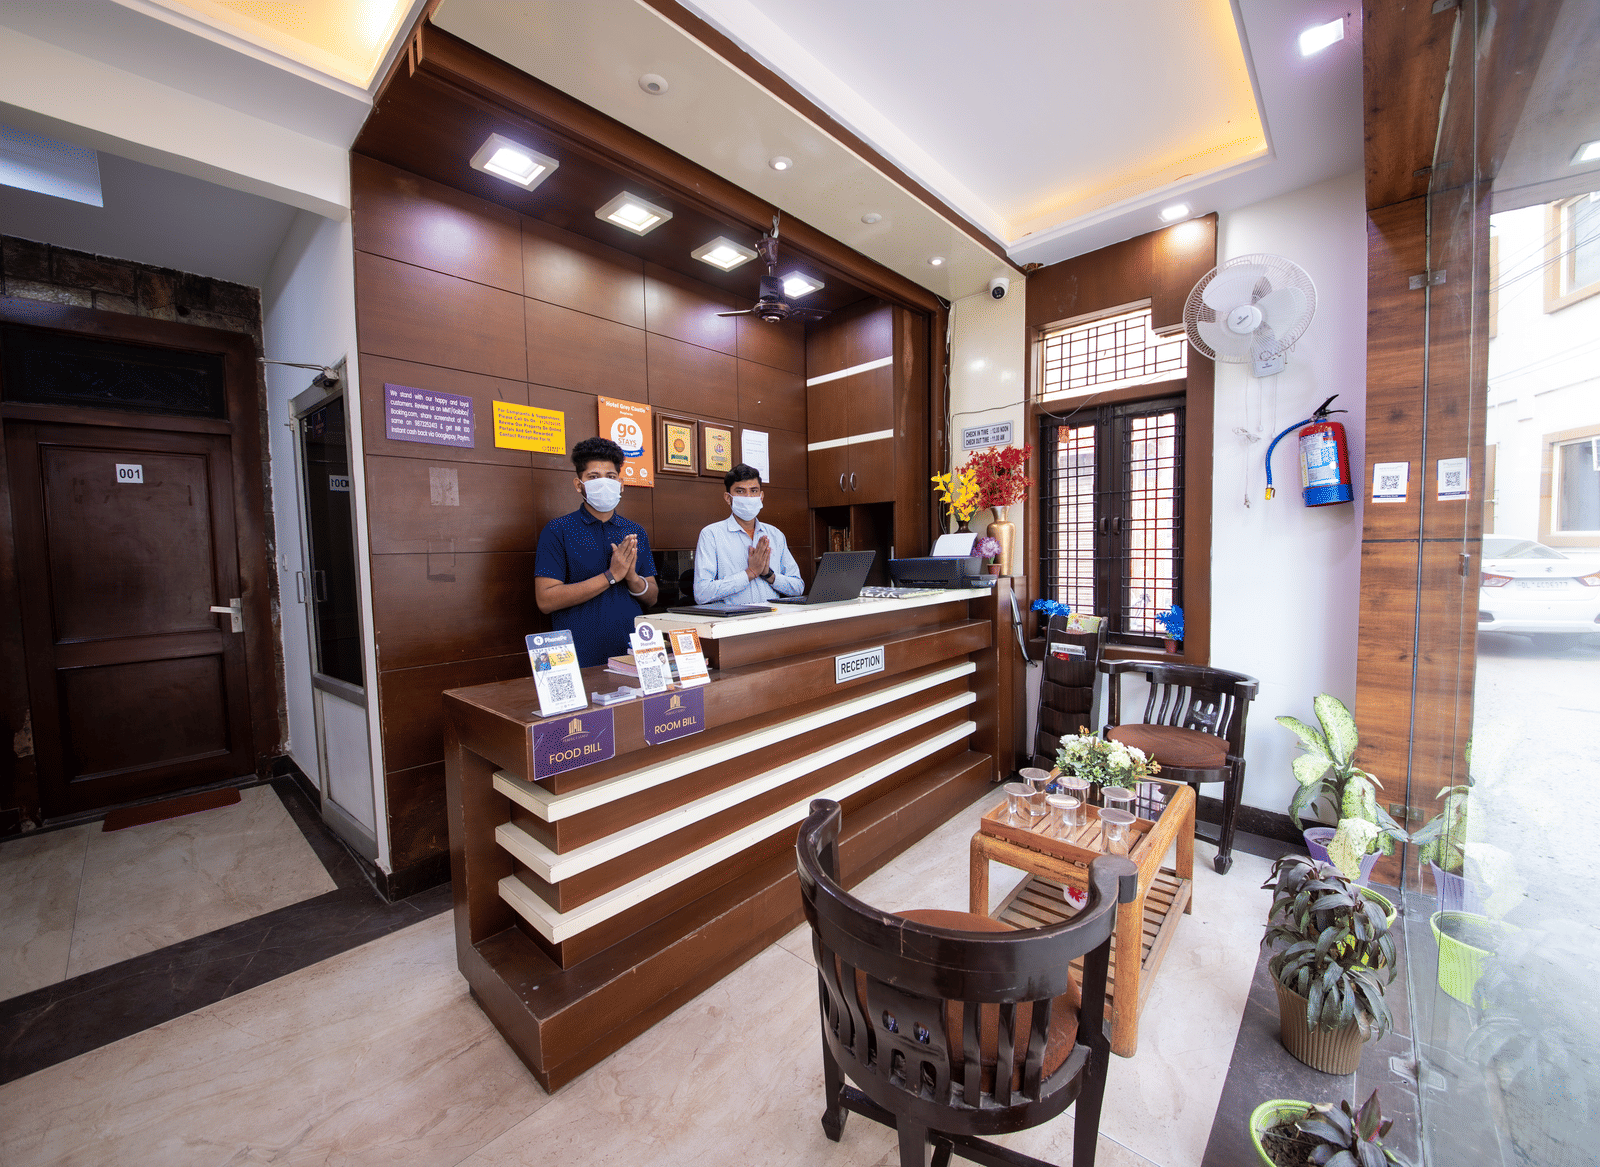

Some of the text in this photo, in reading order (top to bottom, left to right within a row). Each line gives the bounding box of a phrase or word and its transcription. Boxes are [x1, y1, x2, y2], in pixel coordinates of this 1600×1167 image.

[435, 397, 448, 406] happy
[617, 423, 636, 438] go
[618, 438, 636, 446] STAYS
[120, 468, 140, 479] 001
[841, 655, 880, 674] RECEPTION
[655, 716, 696, 734] ROOM BILL
[549, 742, 602, 764] FOOD BILL
